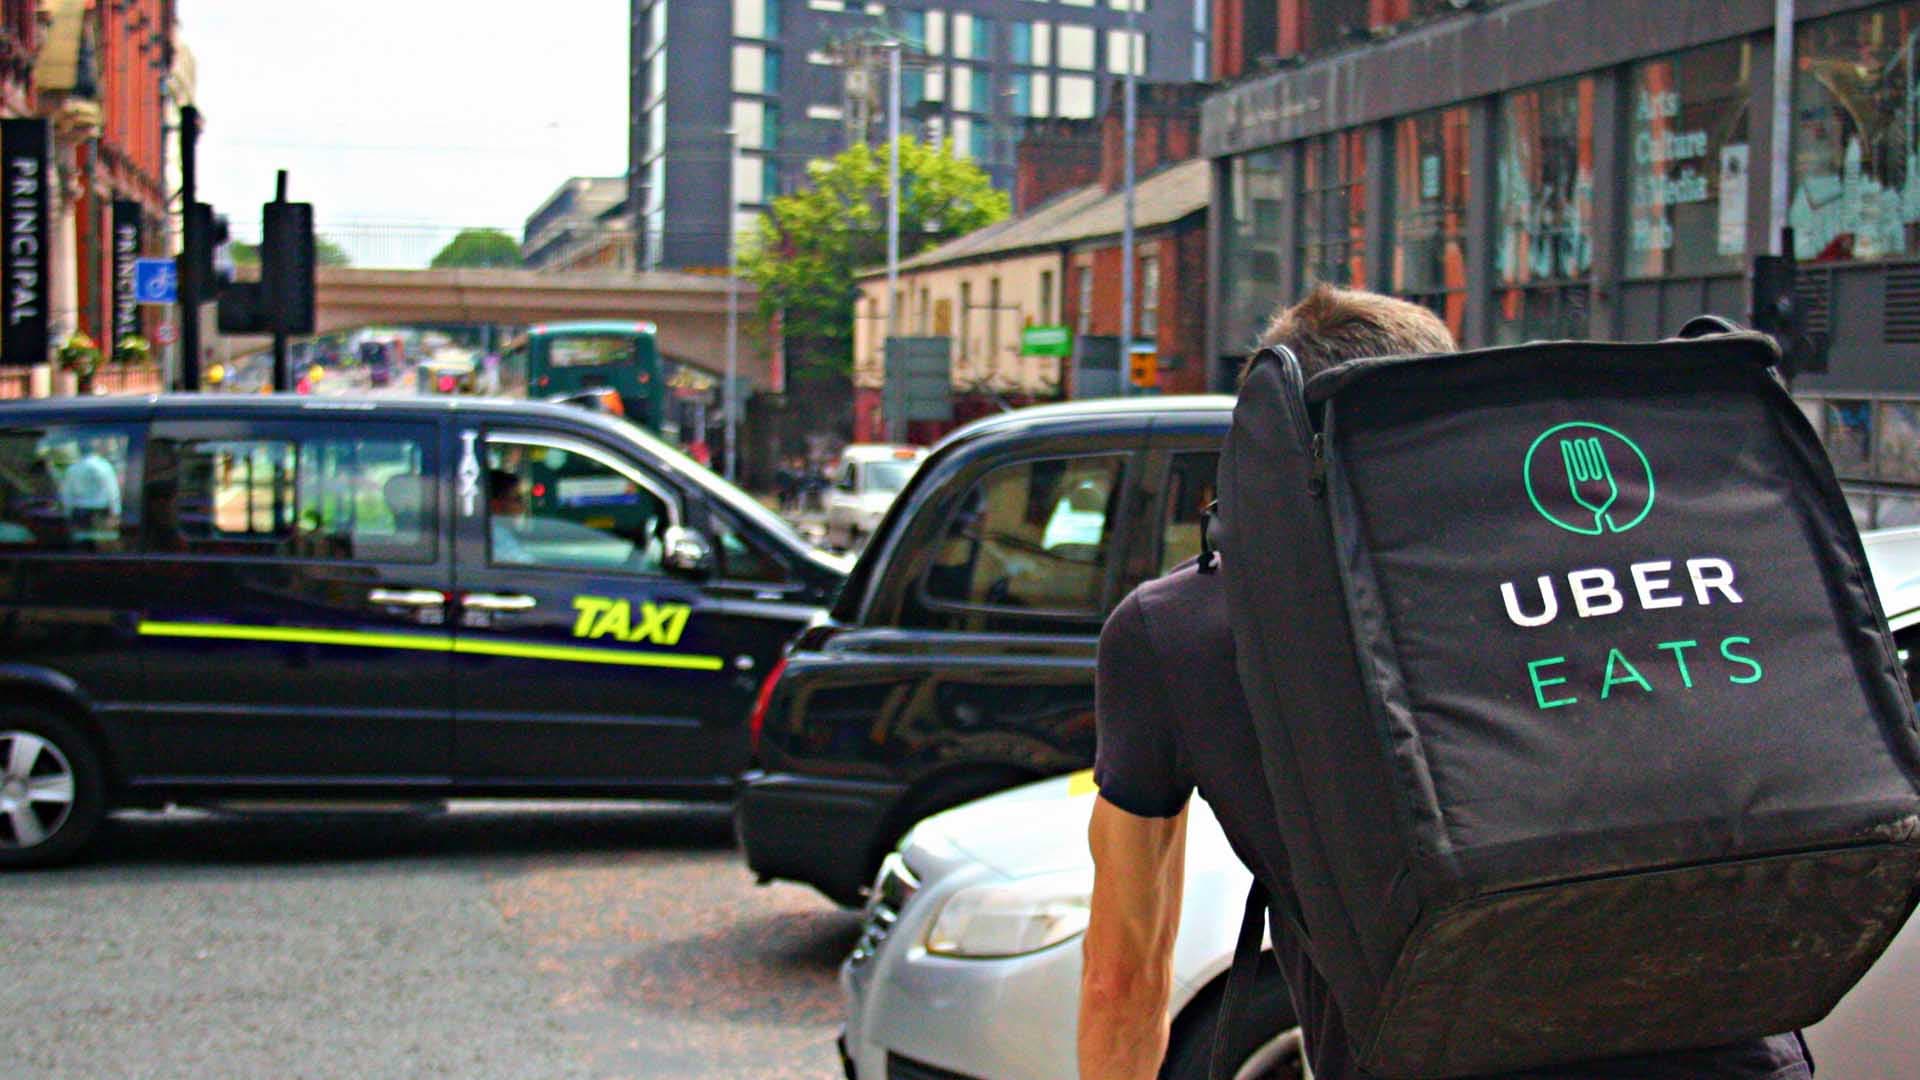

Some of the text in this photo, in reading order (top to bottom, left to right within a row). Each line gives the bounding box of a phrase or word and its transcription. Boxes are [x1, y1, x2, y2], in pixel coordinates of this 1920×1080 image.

[1635, 129, 1708, 164] Culture
[11, 157, 39, 324] PRINCIPAL
[572, 596, 692, 645] TAXI
[1500, 557, 1744, 627] UBER
[1526, 636, 1764, 710] EATS
